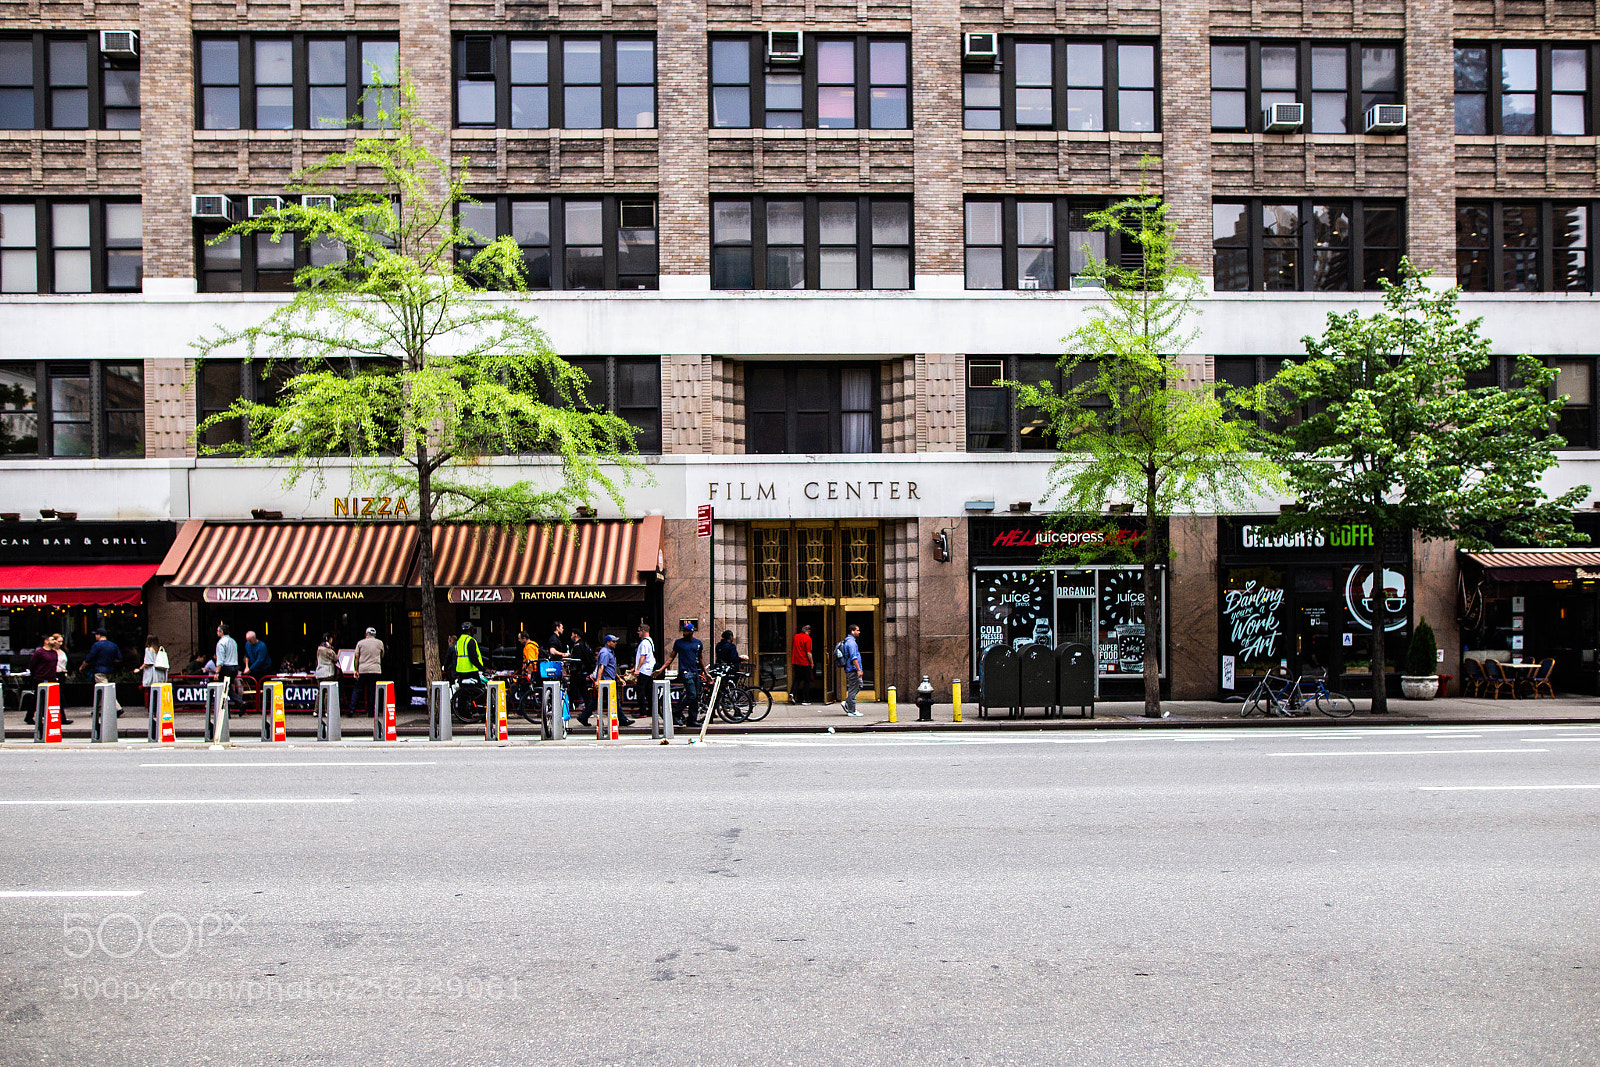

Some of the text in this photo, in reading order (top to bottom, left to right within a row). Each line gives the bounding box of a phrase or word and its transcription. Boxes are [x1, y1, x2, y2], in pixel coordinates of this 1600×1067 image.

[708, 481, 921, 500] FILM CENTER
[333, 497, 410, 516] NIZZA
[84, 537, 92, 545] &
[1034, 529, 1105, 545] juicepress
[1330, 524, 1375, 547] COFFE
[216, 588, 259, 601] NIZZA
[277, 591, 365, 600] TRATTORIA ITALIANA
[460, 589, 502, 601] NIZZA
[520, 590, 607, 600] TRATTORIA ITALIANA
[1057, 586, 1096, 597] ORGANIC
[1115, 589, 1146, 605] juice
[2, 594, 48, 603] NAPKIN
[999, 590, 1031, 606] juice
[980, 625, 1003, 634] COLD
[1231, 612, 1280, 642] Work
[1344, 635, 1352, 643] A
[1098, 644, 1118, 652] SUPER
[1239, 630, 1283, 662] Art
[1099, 651, 1119, 660] FOOD
